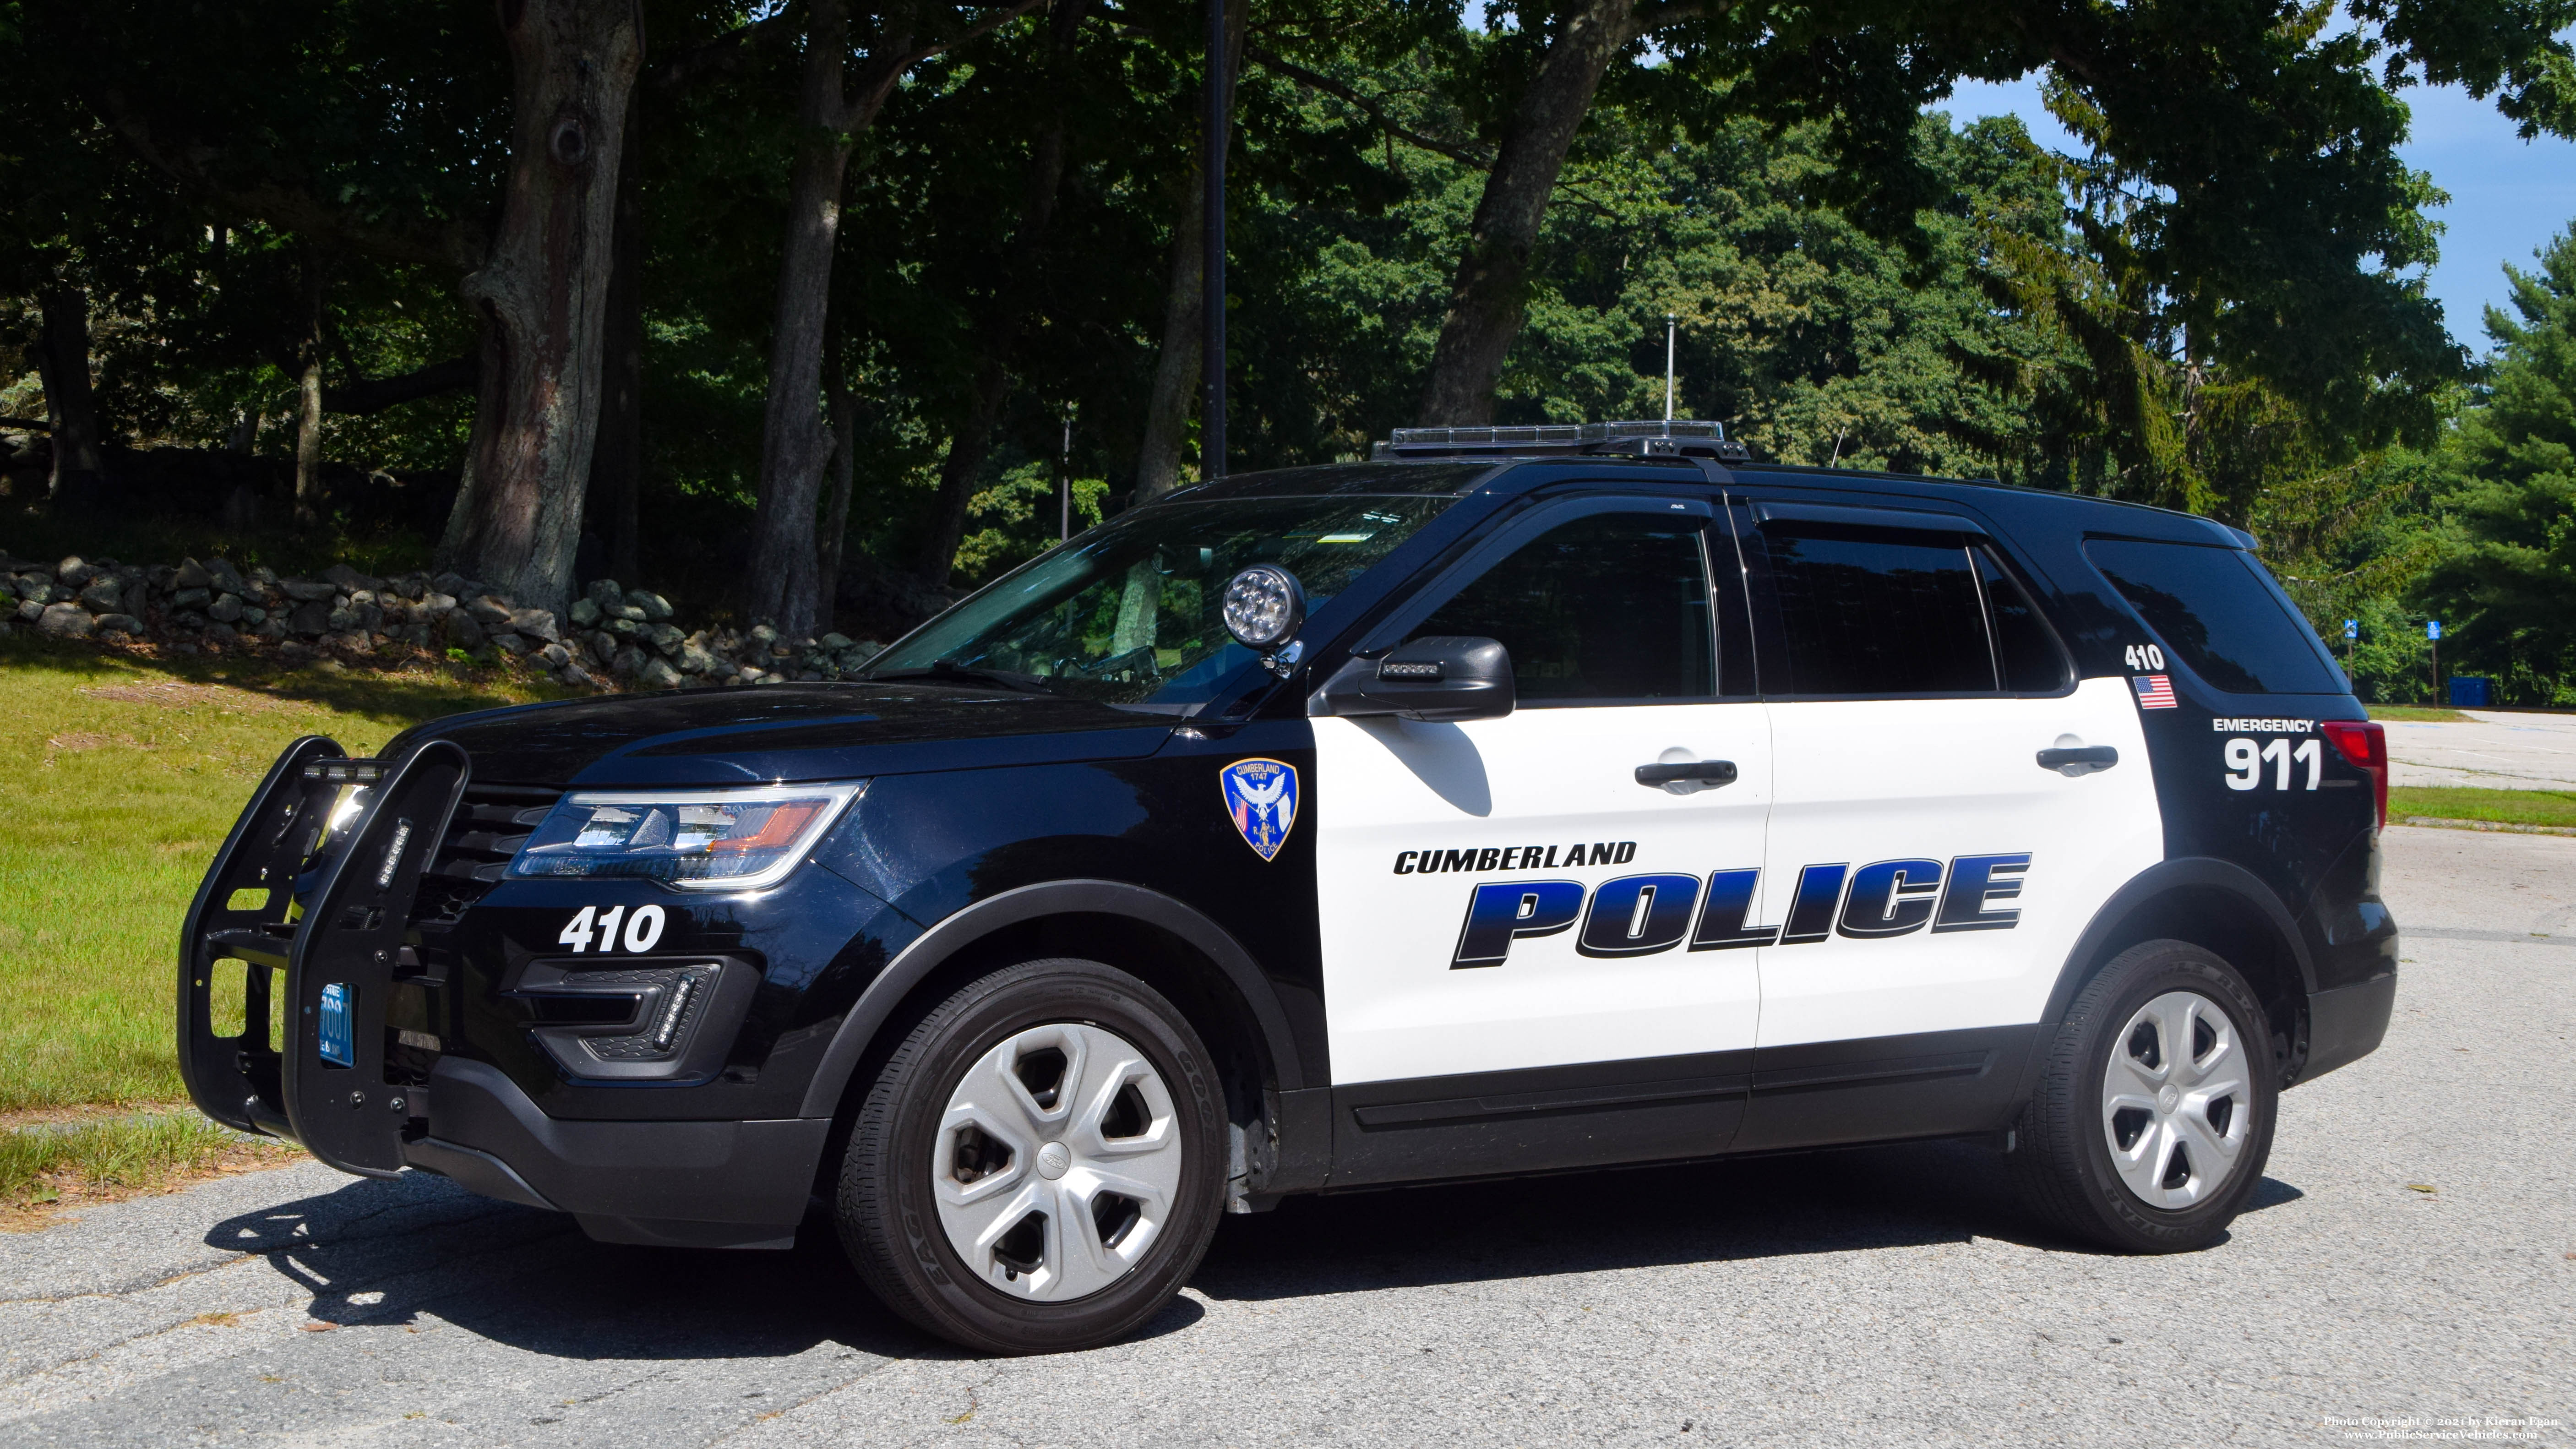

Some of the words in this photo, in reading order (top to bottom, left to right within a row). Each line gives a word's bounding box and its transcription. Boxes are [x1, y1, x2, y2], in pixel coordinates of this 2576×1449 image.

[2125, 644, 2164, 670] 410
[2213, 718, 2315, 732] EMERGENCY
[1236, 763, 1280, 775] CUMBERLAND
[2224, 738, 2321, 791] 911
[1253, 826, 1259, 834] R.
[1255, 841, 1278, 854] POLICE
[1393, 841, 1638, 876] CUMBERLAND
[1449, 851, 2034, 970] POLICE
[558, 904, 665, 953] 410
